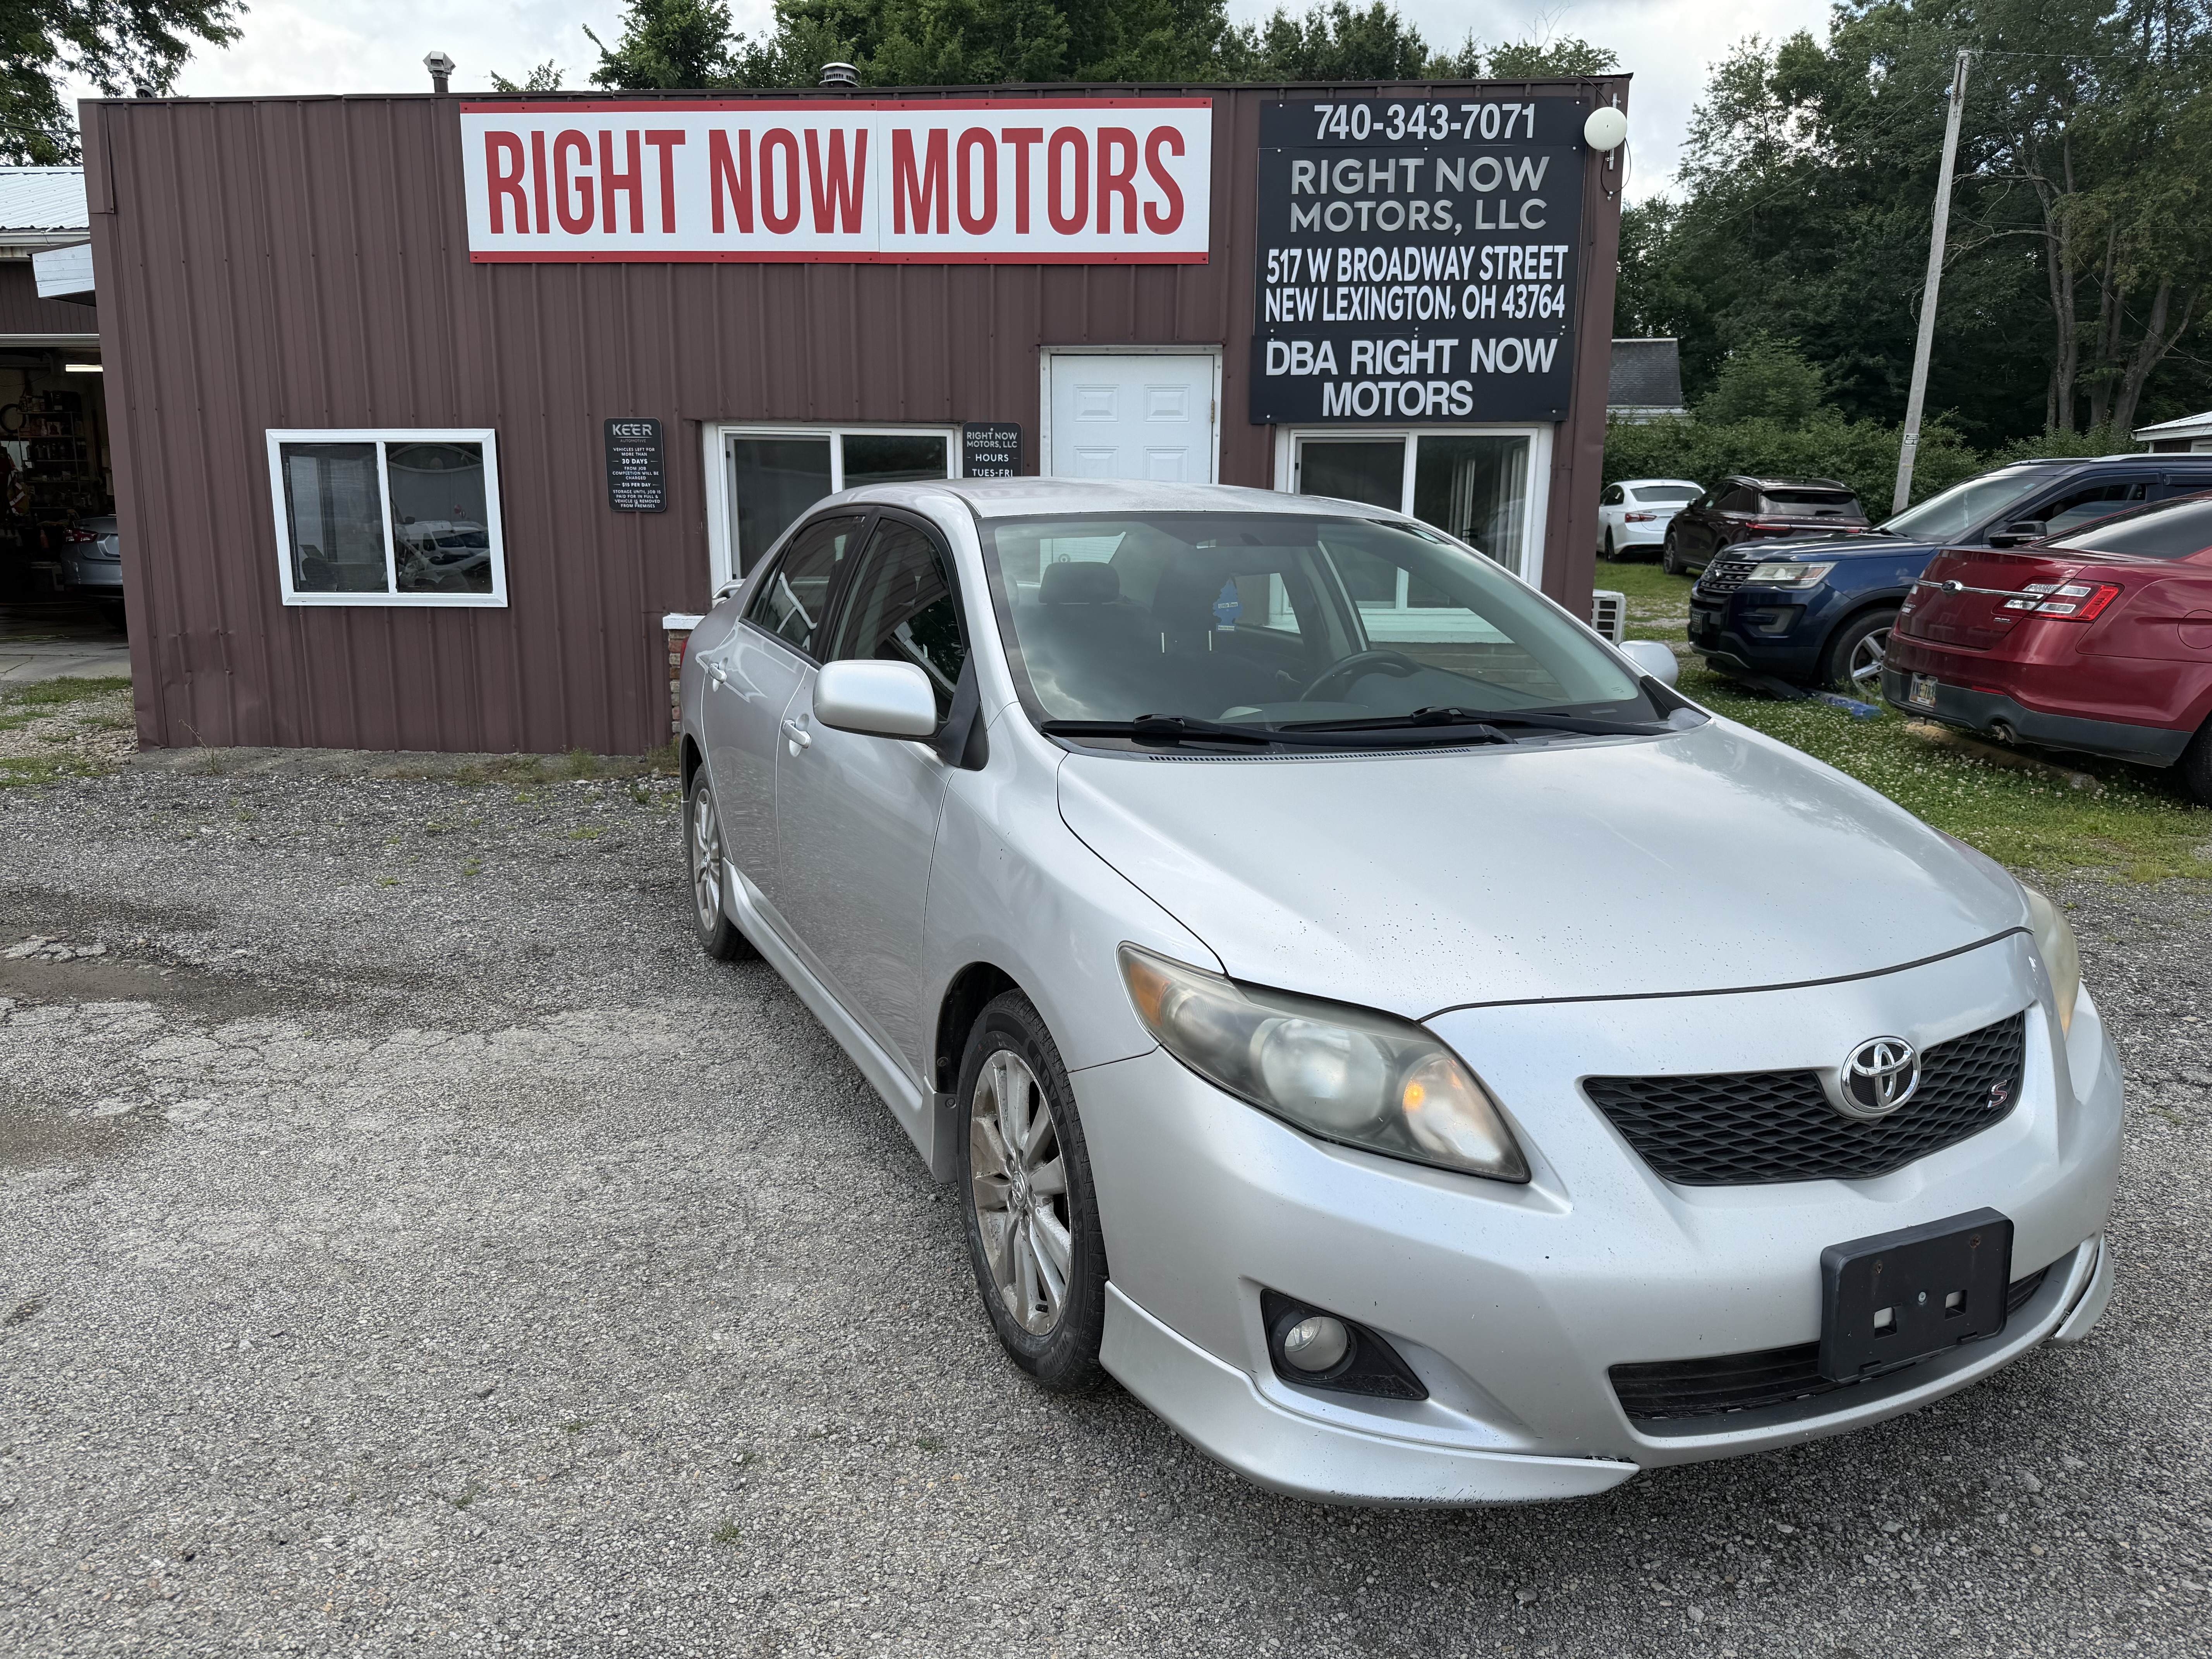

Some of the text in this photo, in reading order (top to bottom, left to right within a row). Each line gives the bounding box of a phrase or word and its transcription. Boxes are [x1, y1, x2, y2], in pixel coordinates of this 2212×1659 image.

[1314, 103, 1535, 140] 740-343-7071
[484, 125, 1185, 235] RIGHT NOW MOTORS
[1291, 156, 1550, 194] RIGHT NOW
[1290, 198, 1547, 236] MOTORS, LLC
[1266, 245, 1568, 284] 517 W BROADWAY STREET
[1265, 284, 1565, 322] NEW LEXINGTON, OH 43764
[1266, 338, 1558, 376] DBA RIGHT NOW
[1322, 381, 1473, 417] MOTORS
[612, 424, 653, 436] KEER
[967, 431, 993, 440] RIGHT
[967, 441, 1001, 449] MOTORS,
[972, 469, 1013, 477] TUES-FRI
[975, 453, 1009, 462] HOURS
[1987, 1080, 2008, 1108] S
